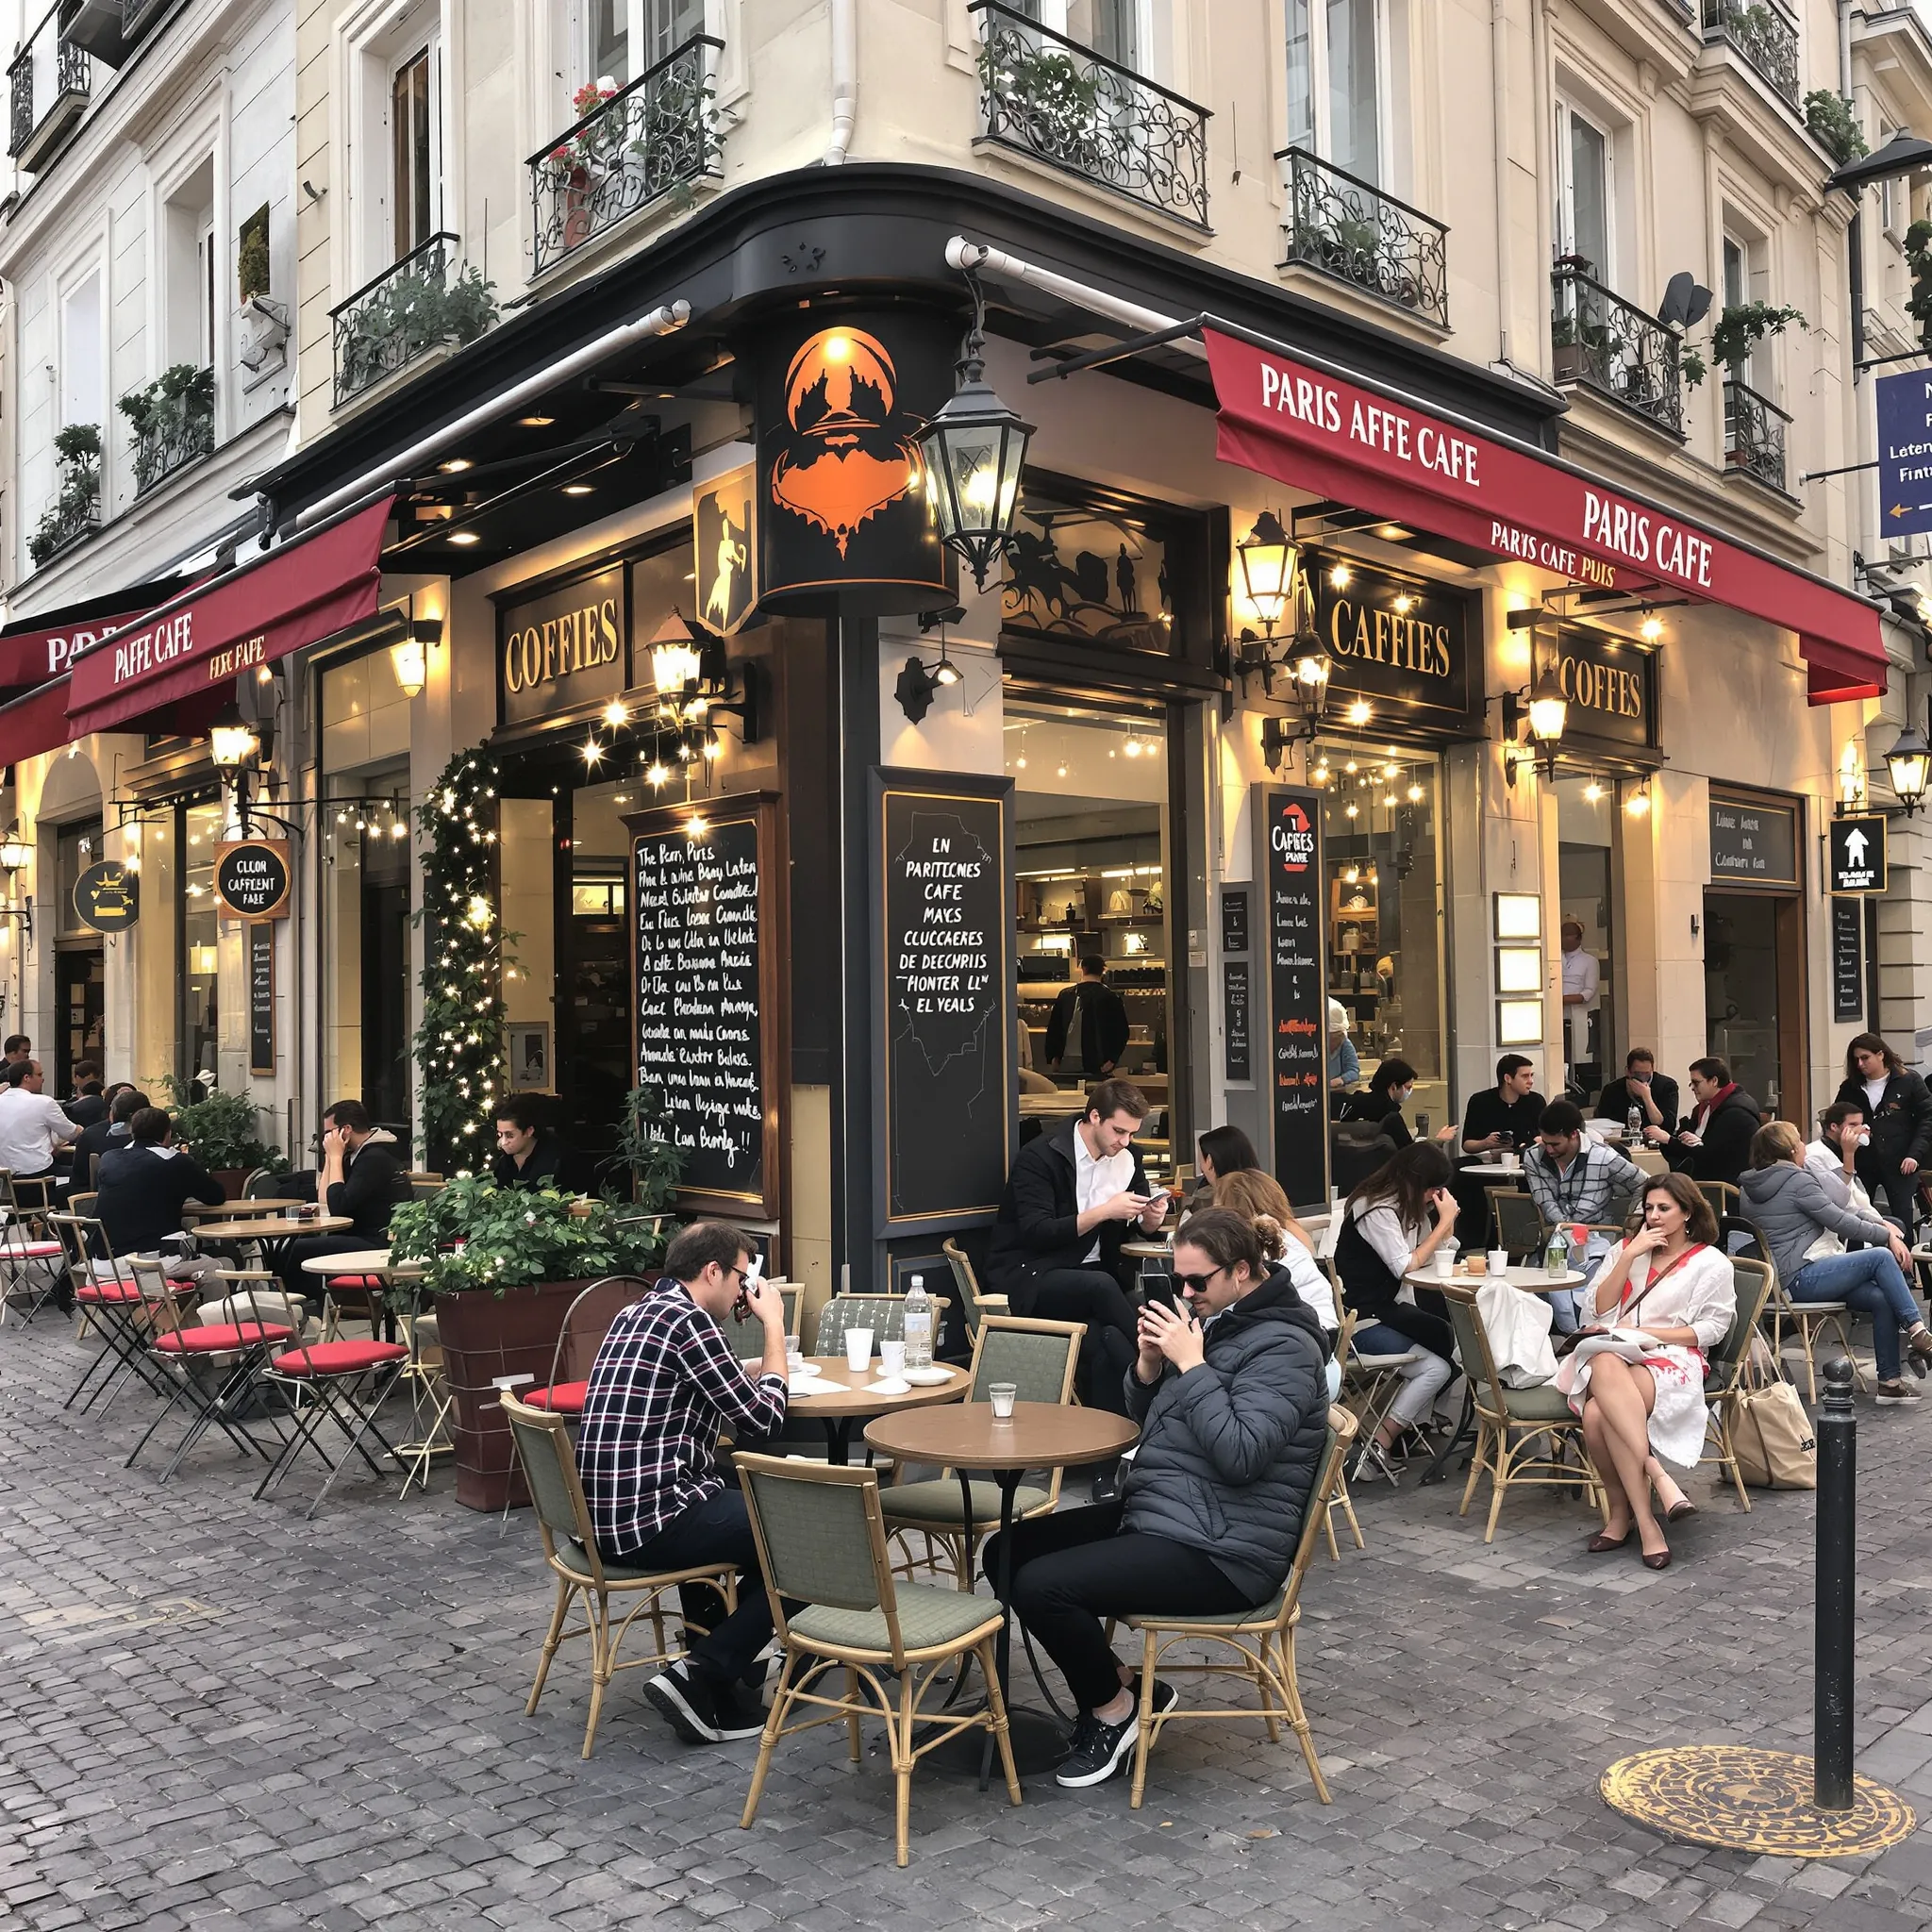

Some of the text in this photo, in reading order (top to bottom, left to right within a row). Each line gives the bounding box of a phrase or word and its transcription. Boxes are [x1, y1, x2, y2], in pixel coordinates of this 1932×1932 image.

[1260, 362, 1480, 487] PARIS AFFE CAFE
[1491, 521, 1537, 560] PARIS
[1541, 541, 1576, 575] CAFE
[1582, 491, 1712, 588] PARIS CAFE
[155, 611, 193, 663] CAFE
[505, 598, 618, 692] COFFIES
[1331, 599, 1451, 677] CAFFIES
[1559, 656, 1641, 718] COFFES
[637, 847, 658, 867] The
[924, 883, 963, 901] CAFE
[899, 954, 918, 970] DE
